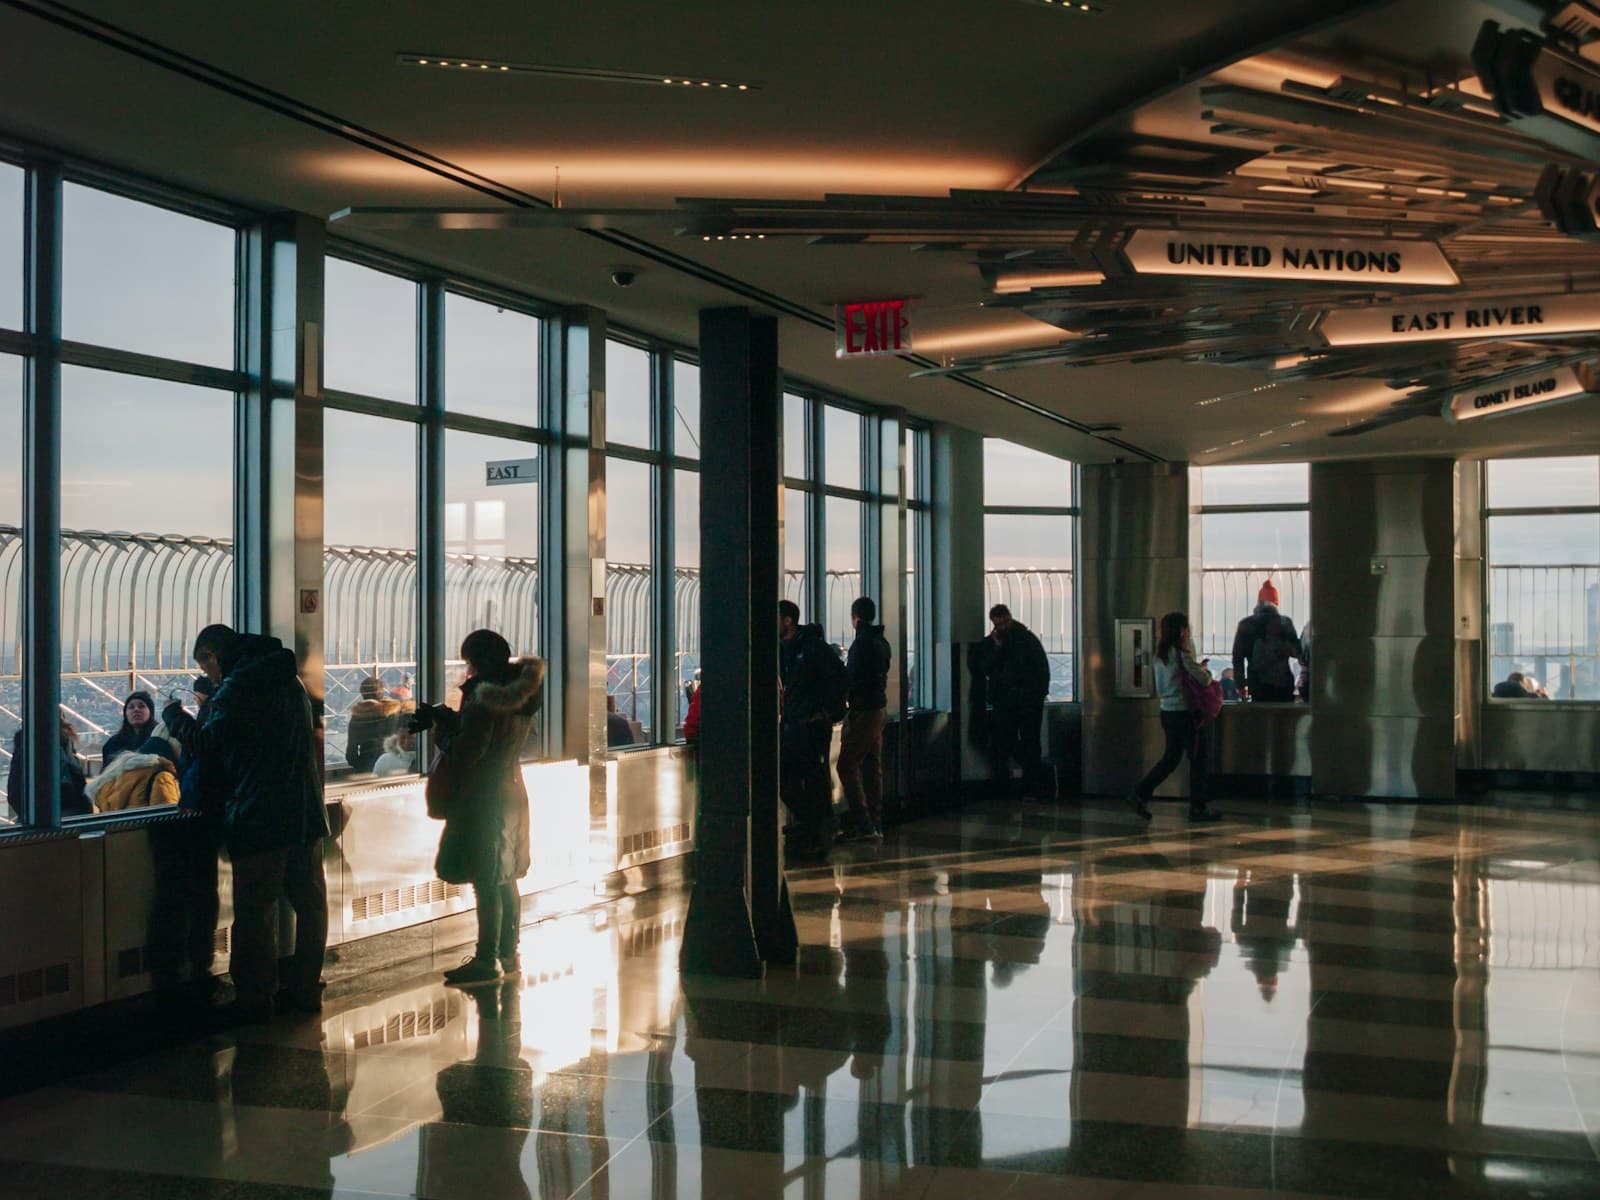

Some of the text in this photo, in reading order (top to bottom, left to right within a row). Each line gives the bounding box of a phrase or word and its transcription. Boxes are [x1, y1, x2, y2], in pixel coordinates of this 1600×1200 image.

[1167, 241, 1401, 273] UNITED NATIONS
[845, 299, 905, 353] EXIT
[1392, 306, 1545, 333] EAST RIVER
[1474, 378, 1557, 410] CONEY ISLAND
[487, 465, 520, 481] EAST
